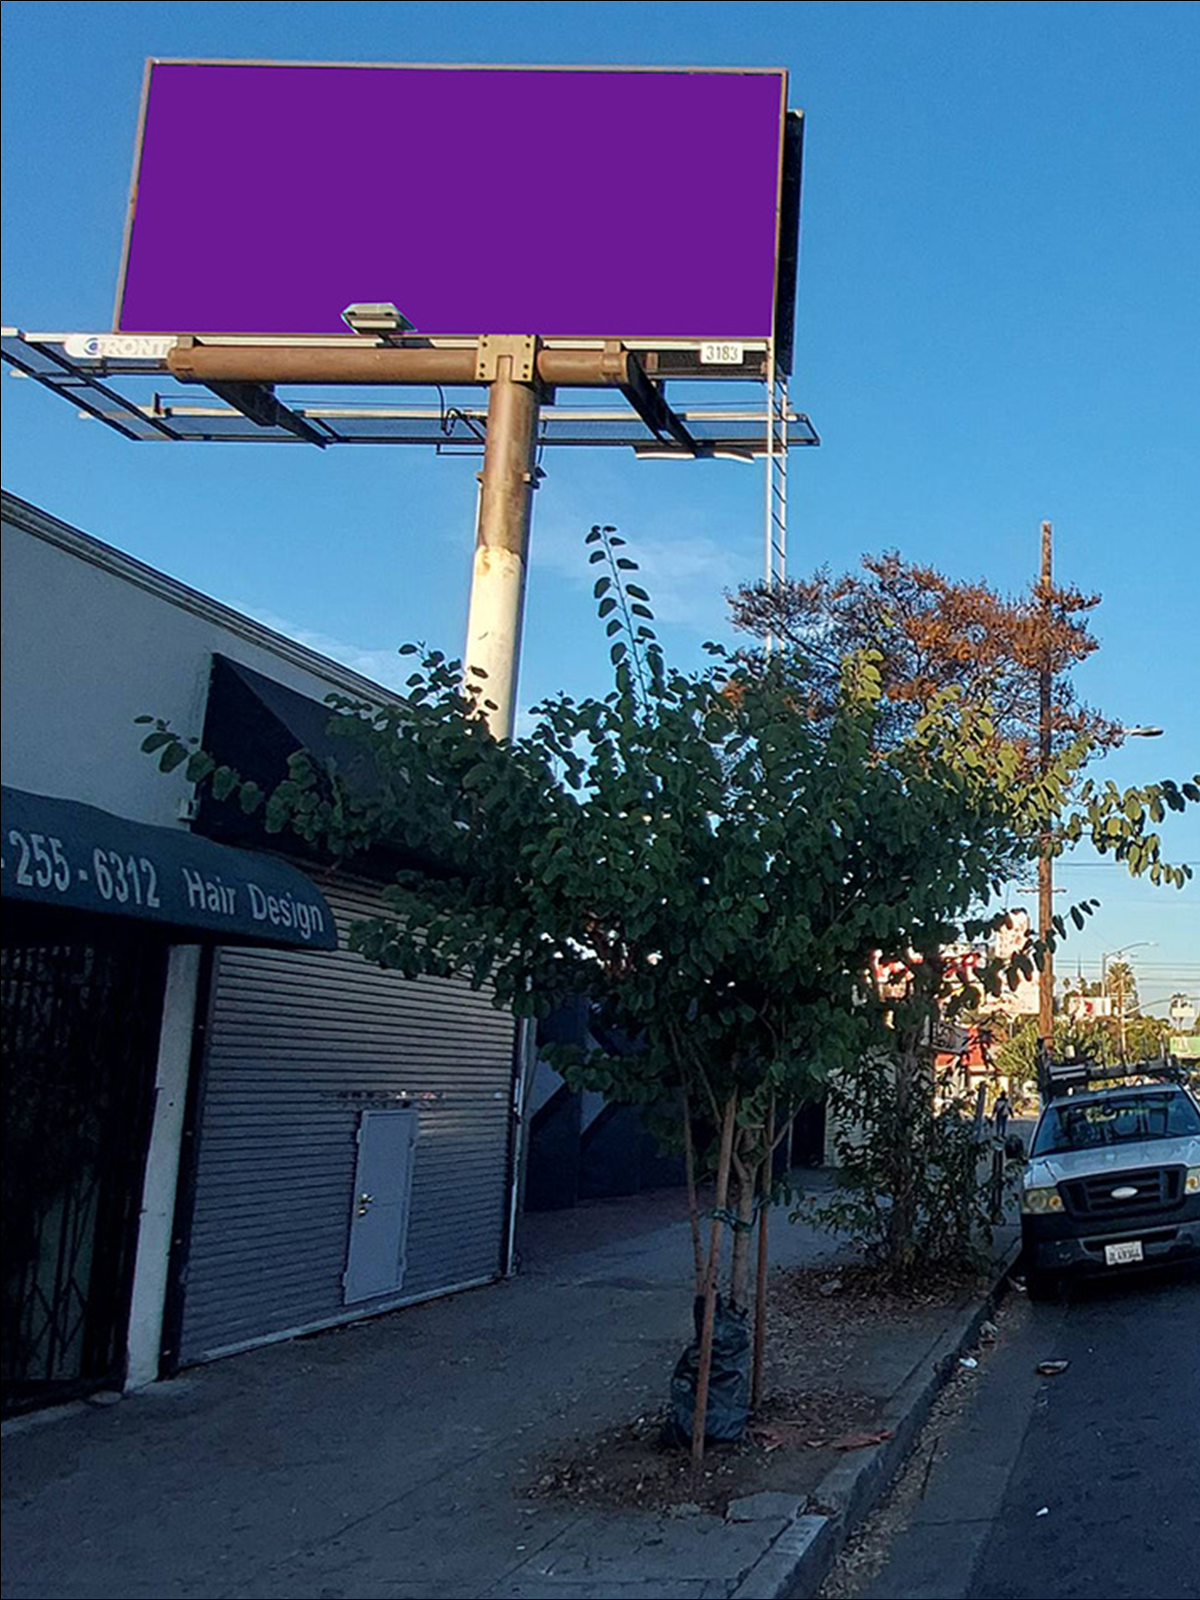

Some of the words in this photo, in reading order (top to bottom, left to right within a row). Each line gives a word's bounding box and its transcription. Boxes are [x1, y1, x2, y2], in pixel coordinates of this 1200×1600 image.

[706, 345, 738, 360] 3183
[182, 867, 236, 916] Hair
[248, 883, 325, 939] Design
